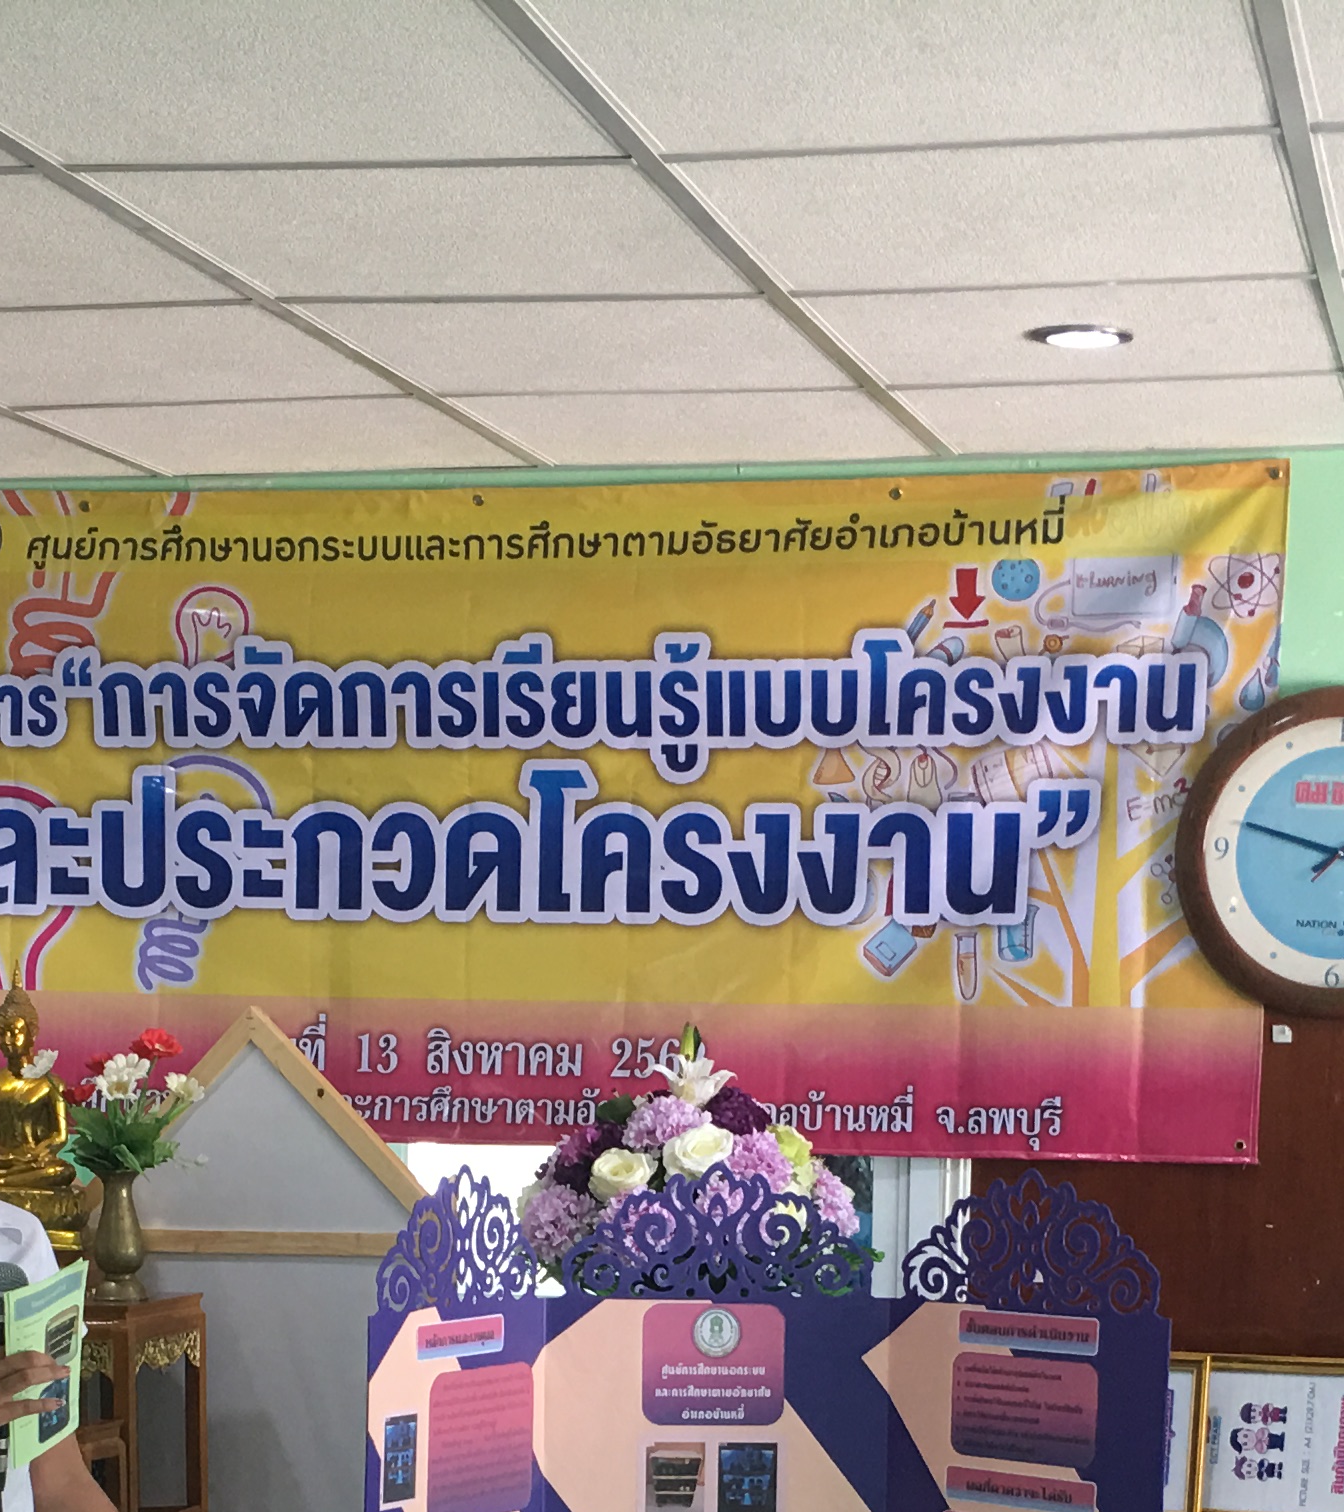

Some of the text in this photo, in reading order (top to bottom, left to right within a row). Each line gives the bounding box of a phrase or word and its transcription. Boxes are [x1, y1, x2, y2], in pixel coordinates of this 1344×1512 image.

[27, 494, 1065, 572] ศูนย์การศึกษานอกระบบและการศึกษาตามอัธยาศัยอำเภอบ้านหมี่
[1214, 837, 1229, 860] 9
[1295, 918, 1337, 929] NATION
[1324, 966, 1340, 988] 6
[357, 1033, 398, 1074] 13
[426, 1027, 584, 1077] สิงหาคม
[935, 1096, 1064, 1151] จ.ลพบุรี
